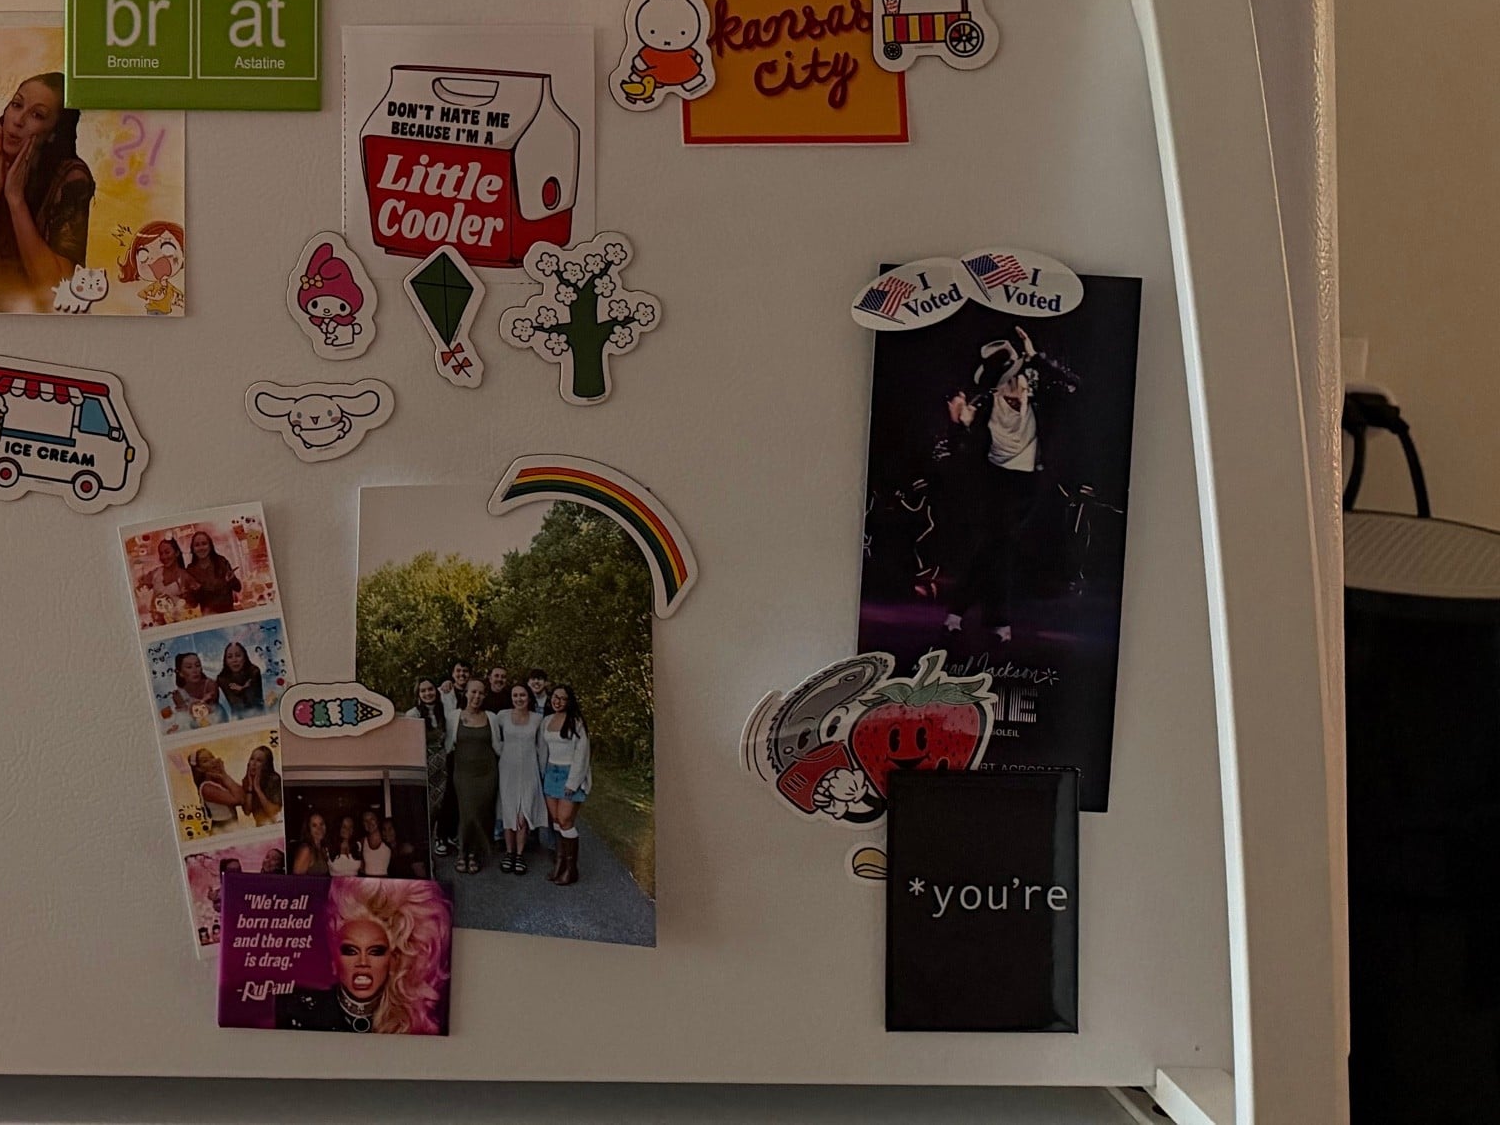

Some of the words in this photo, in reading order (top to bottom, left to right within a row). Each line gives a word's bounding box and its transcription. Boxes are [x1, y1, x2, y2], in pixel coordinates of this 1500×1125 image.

[108, 55, 160, 69] Bromine
[234, 55, 286, 70] Astatine
[754, 47, 859, 109] city
[387, 101, 434, 121] DON'T
[440, 107, 480, 125] HATE
[486, 111, 510, 128] ME
[391, 121, 450, 140] BECAUSE
[456, 128, 479, 144] I'M
[484, 131, 494, 145] A
[377, 154, 503, 203] Little
[378, 198, 504, 246] Cooler
[916, 272, 931, 291] I
[1029, 268, 1042, 286] I
[902, 283, 963, 317] Voted
[1003, 284, 1061, 312] Voted
[4, 441, 32, 456] ICE
[37, 447, 94, 467] CREAM
[244, 894, 288, 910] "We're
[290, 894, 309, 910] all
[237, 914, 268, 929] born
[270, 914, 314, 929] naked
[233, 933, 260, 948] and
[261, 934, 283, 948] the
[285, 935, 313, 949] rest
[244, 952, 256, 967] is
